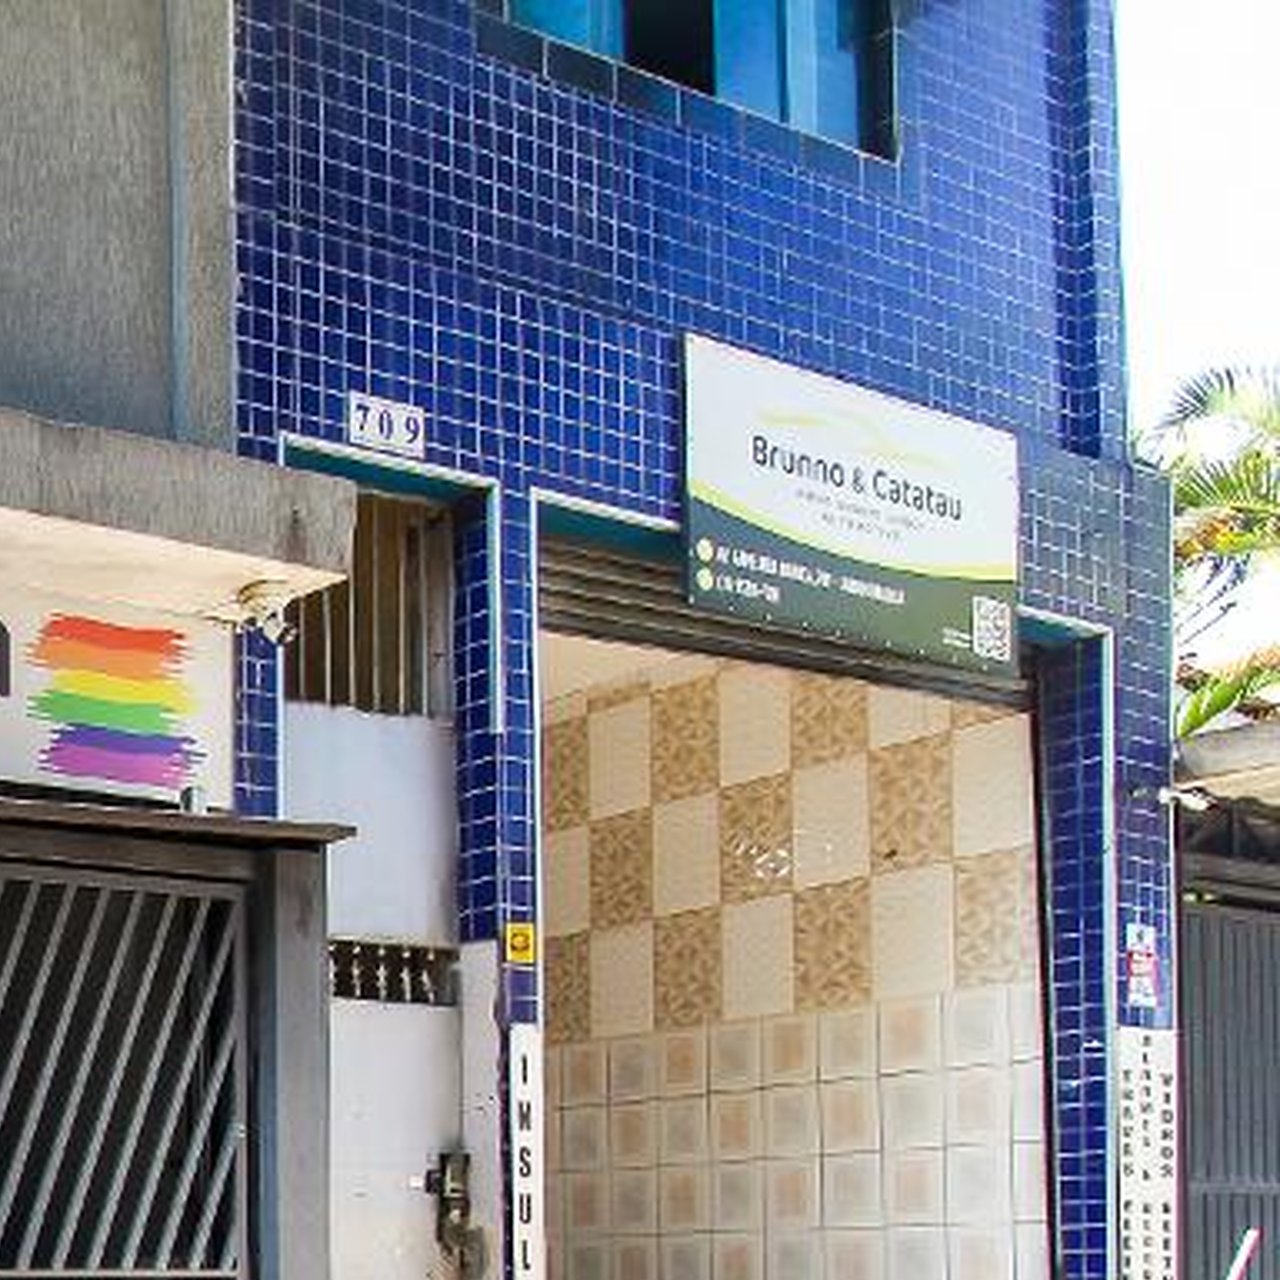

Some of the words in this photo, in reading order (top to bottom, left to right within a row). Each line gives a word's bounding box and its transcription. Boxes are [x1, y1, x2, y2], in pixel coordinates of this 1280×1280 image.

[356, 403, 420, 444] 709
[751, 434, 844, 488] Brunno
[849, 467, 867, 495] &
[872, 469, 963, 522] Catatau
